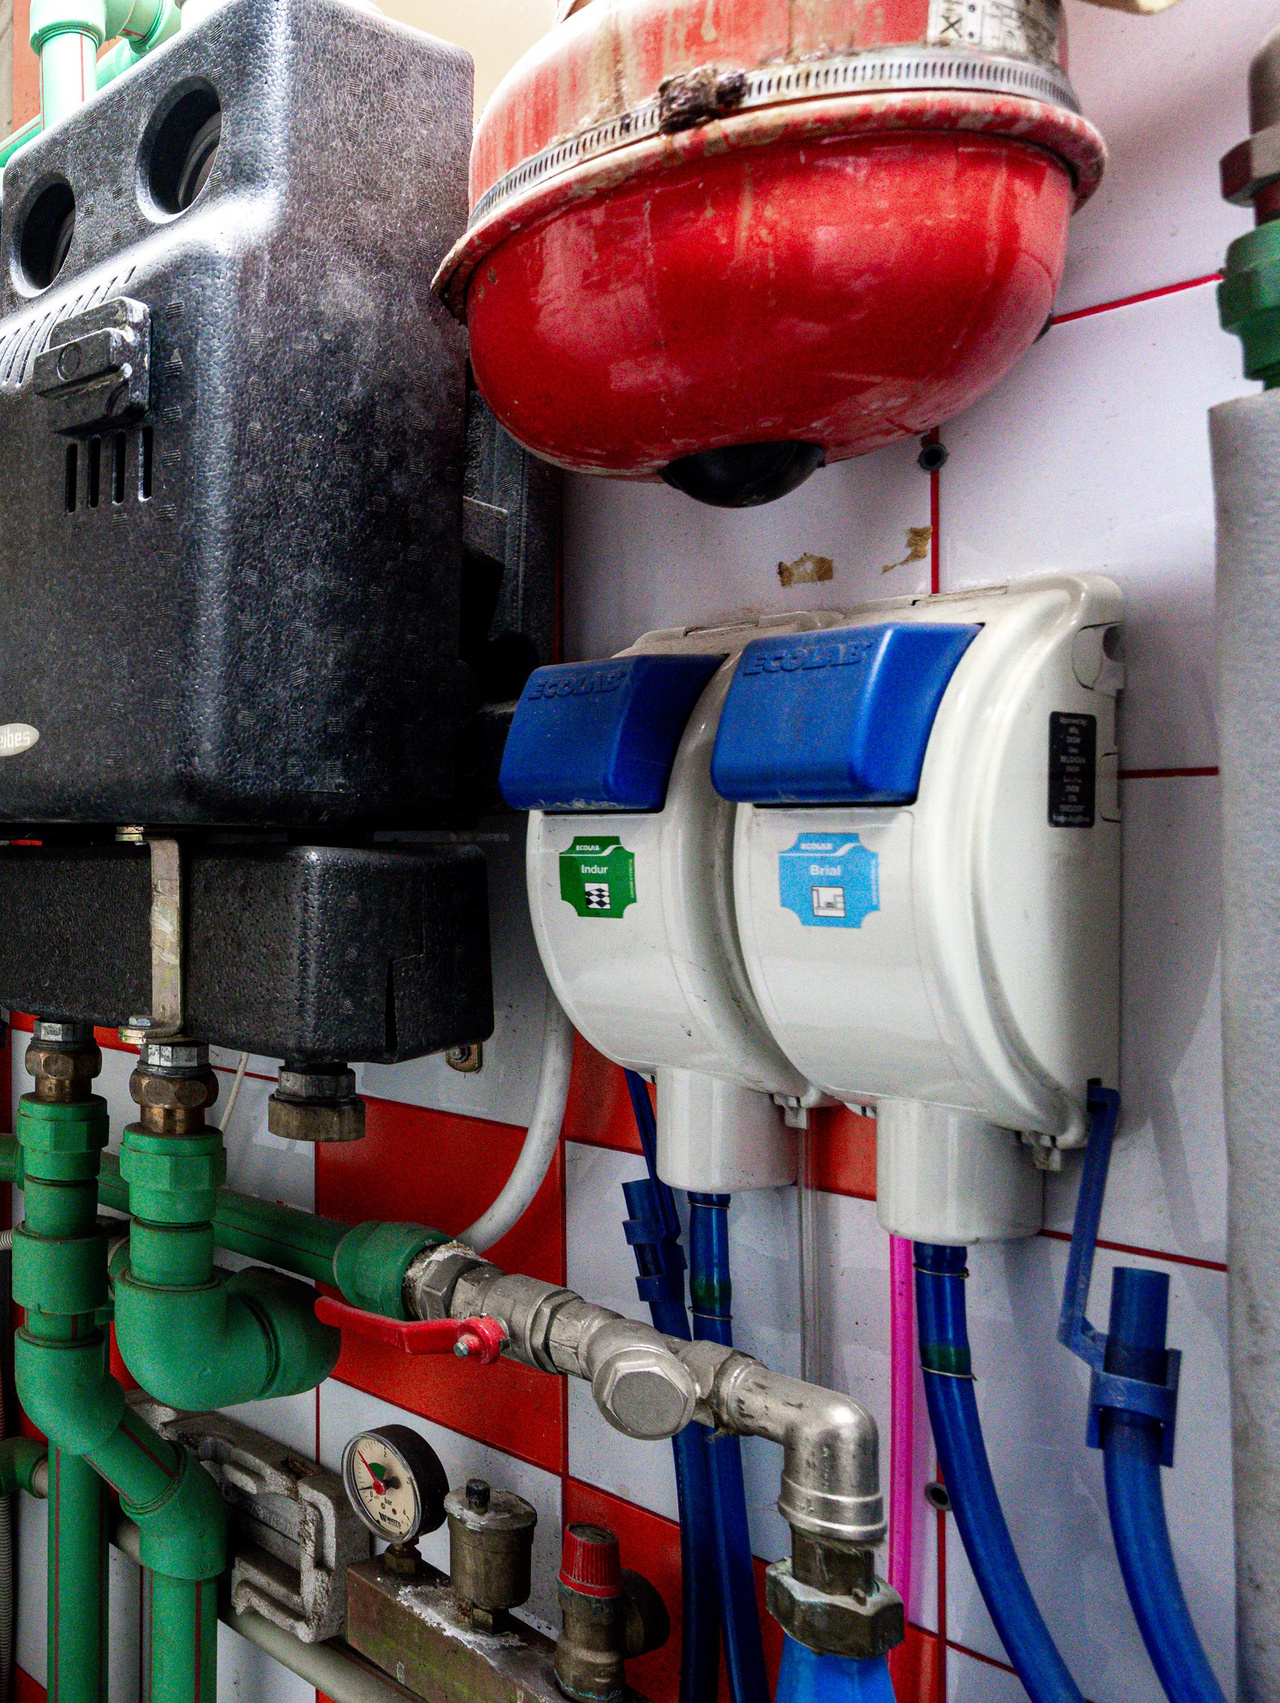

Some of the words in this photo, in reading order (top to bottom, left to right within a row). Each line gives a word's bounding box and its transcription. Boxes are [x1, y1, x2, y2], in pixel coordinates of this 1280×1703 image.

[742, 643, 867, 677] ECOLAB
[581, 864, 608, 874] Indur
[810, 864, 842, 876] Brial
